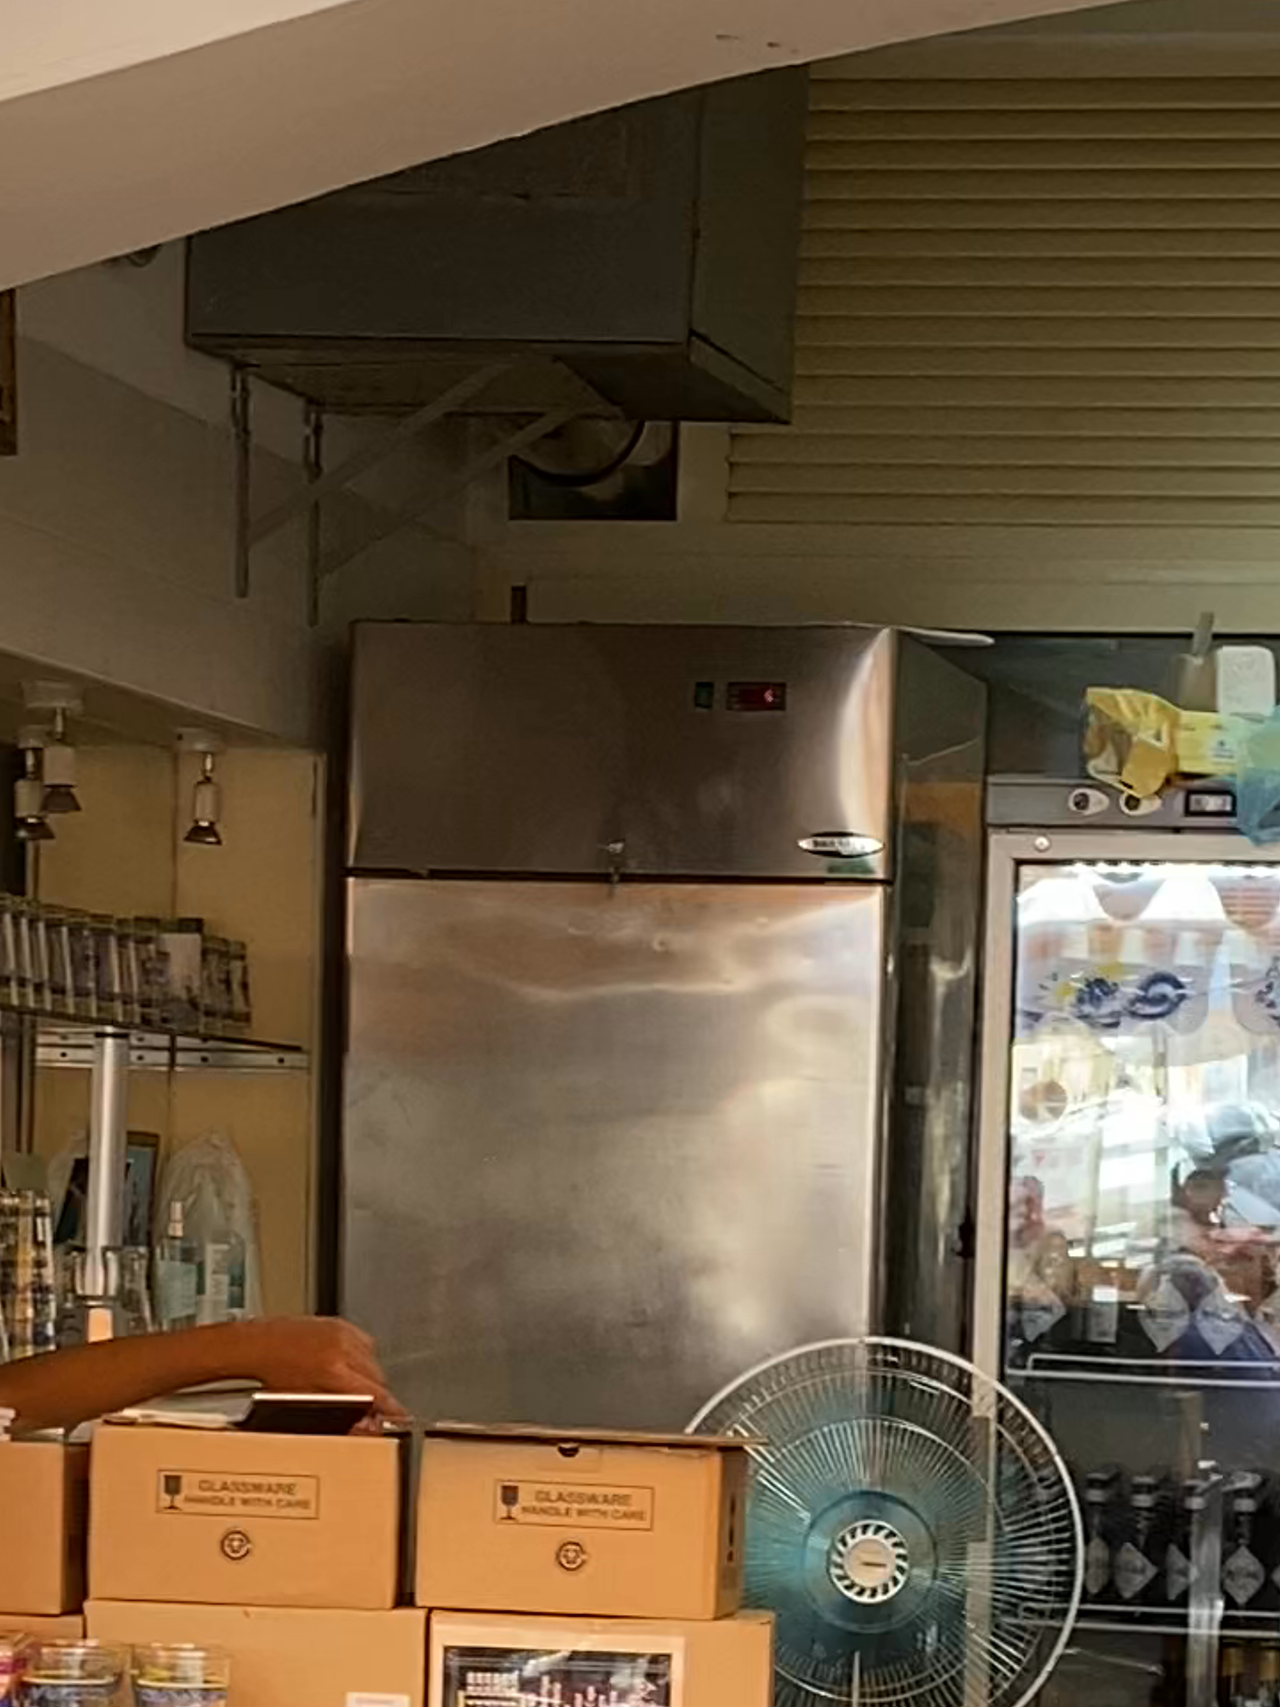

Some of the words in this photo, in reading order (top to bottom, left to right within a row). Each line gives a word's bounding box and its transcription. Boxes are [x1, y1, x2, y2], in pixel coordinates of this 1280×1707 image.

[198, 1479, 298, 1496] GLASSWARE
[240, 1496, 273, 1508] WITH
[276, 1498, 311, 1510] CARE
[534, 1490, 632, 1507] GLASSWARE
[521, 1505, 572, 1518] HANDLE
[576, 1507, 609, 1520] WITH
[611, 1509, 647, 1522] CARE
